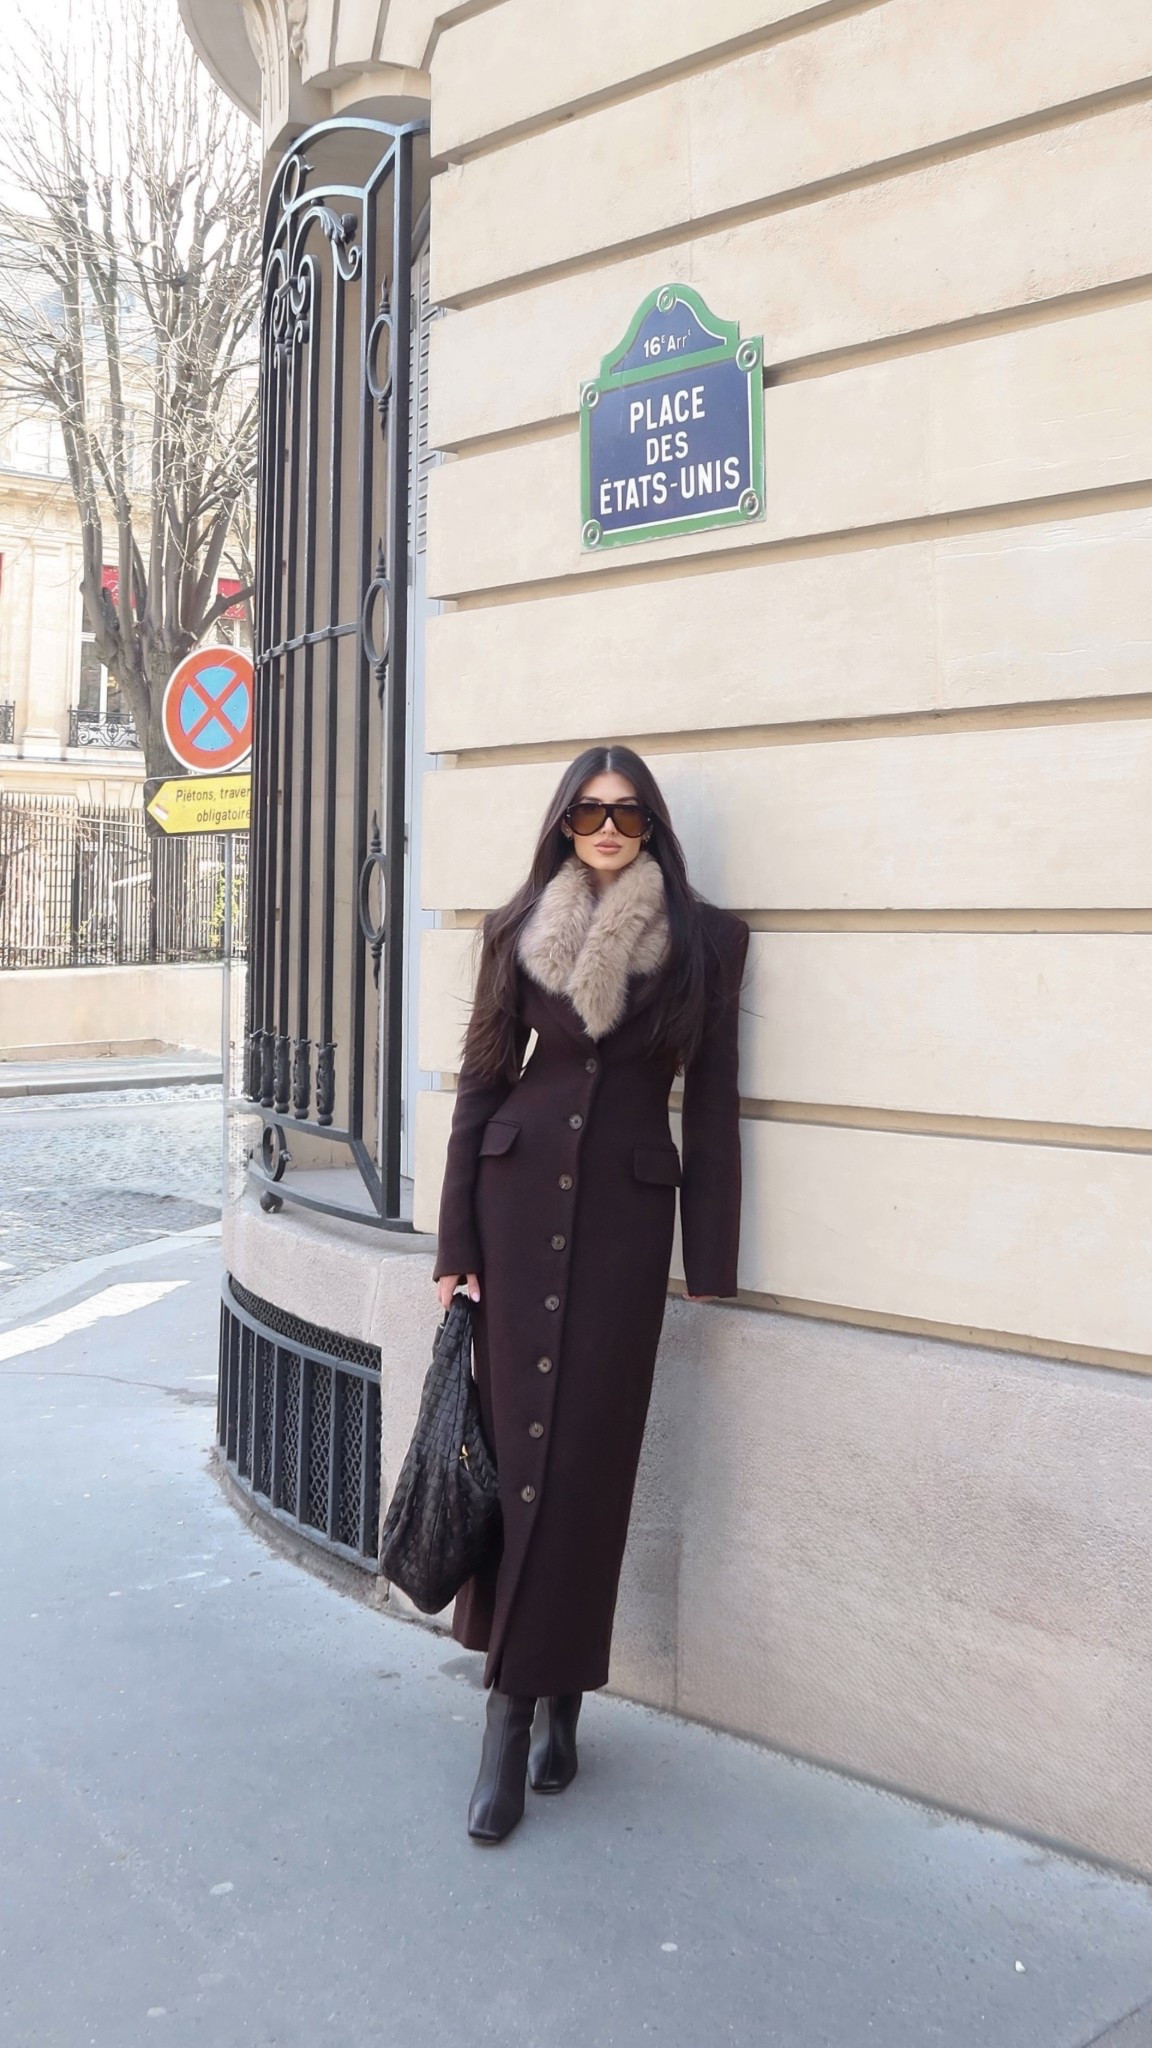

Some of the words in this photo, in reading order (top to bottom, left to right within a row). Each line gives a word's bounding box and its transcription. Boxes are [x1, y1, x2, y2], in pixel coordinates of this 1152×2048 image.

[630, 385, 706, 434] PLACE
[646, 431, 689, 466] DES
[600, 456, 741, 515] ÉTATS-UNIS
[175, 787, 217, 803] Piétons,
